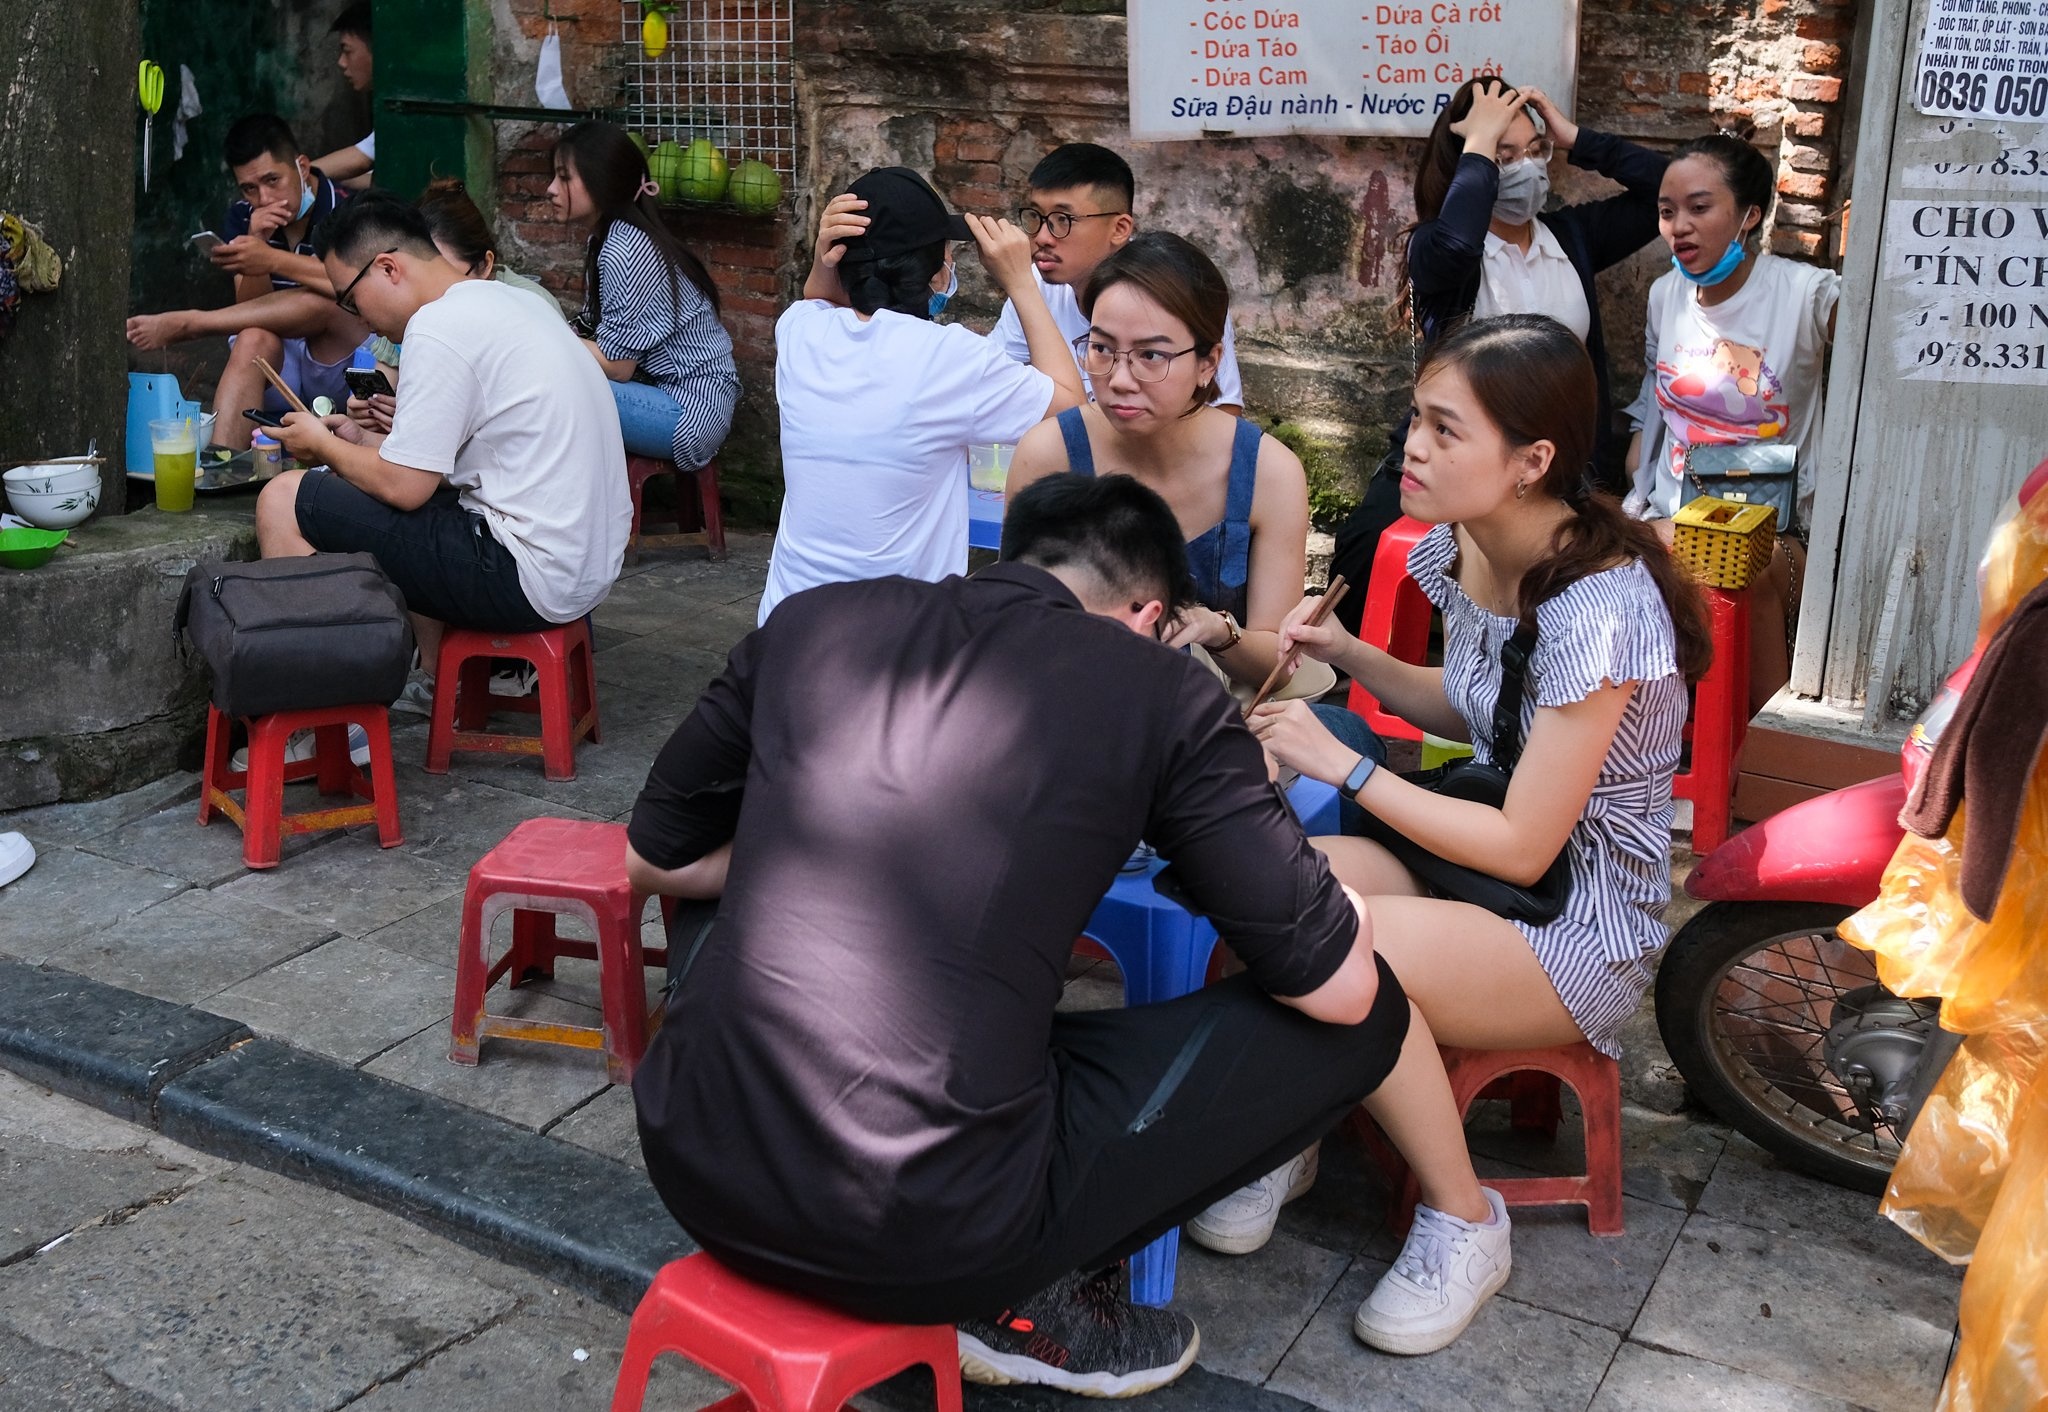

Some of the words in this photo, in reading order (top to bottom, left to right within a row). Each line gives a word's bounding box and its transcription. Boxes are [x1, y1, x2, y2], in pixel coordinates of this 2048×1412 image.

[1204, 11, 1246, 31] Cóc
[1254, 9, 1299, 29] Dứa
[1376, 5, 1423, 25] Dứa
[1431, 3, 1461, 24] Cà
[1205, 39, 1250, 59] Dứa
[1257, 37, 1298, 58] Táo
[1376, 34, 1417, 54] Táo
[1925, 51, 1958, 71] NHẬN
[1961, 55, 1979, 70] THI
[1982, 54, 2015, 72] CÔNG
[1205, 67, 1251, 87] Dứa
[1258, 66, 1308, 85] Cam
[1377, 64, 1426, 84] Cam
[1434, 62, 1463, 83] Cà
[1920, 70, 1988, 113] 0836
[1994, 75, 2048, 118] 050
[1171, 97, 1218, 118] Sữa
[1226, 95, 1272, 121] Đậu
[1281, 93, 1338, 115] nành
[1361, 93, 1425, 114] Nước
[1912, 206, 2015, 239] CHO
[1904, 245, 1984, 287] TÍN
[1962, 302, 2017, 329] 100
